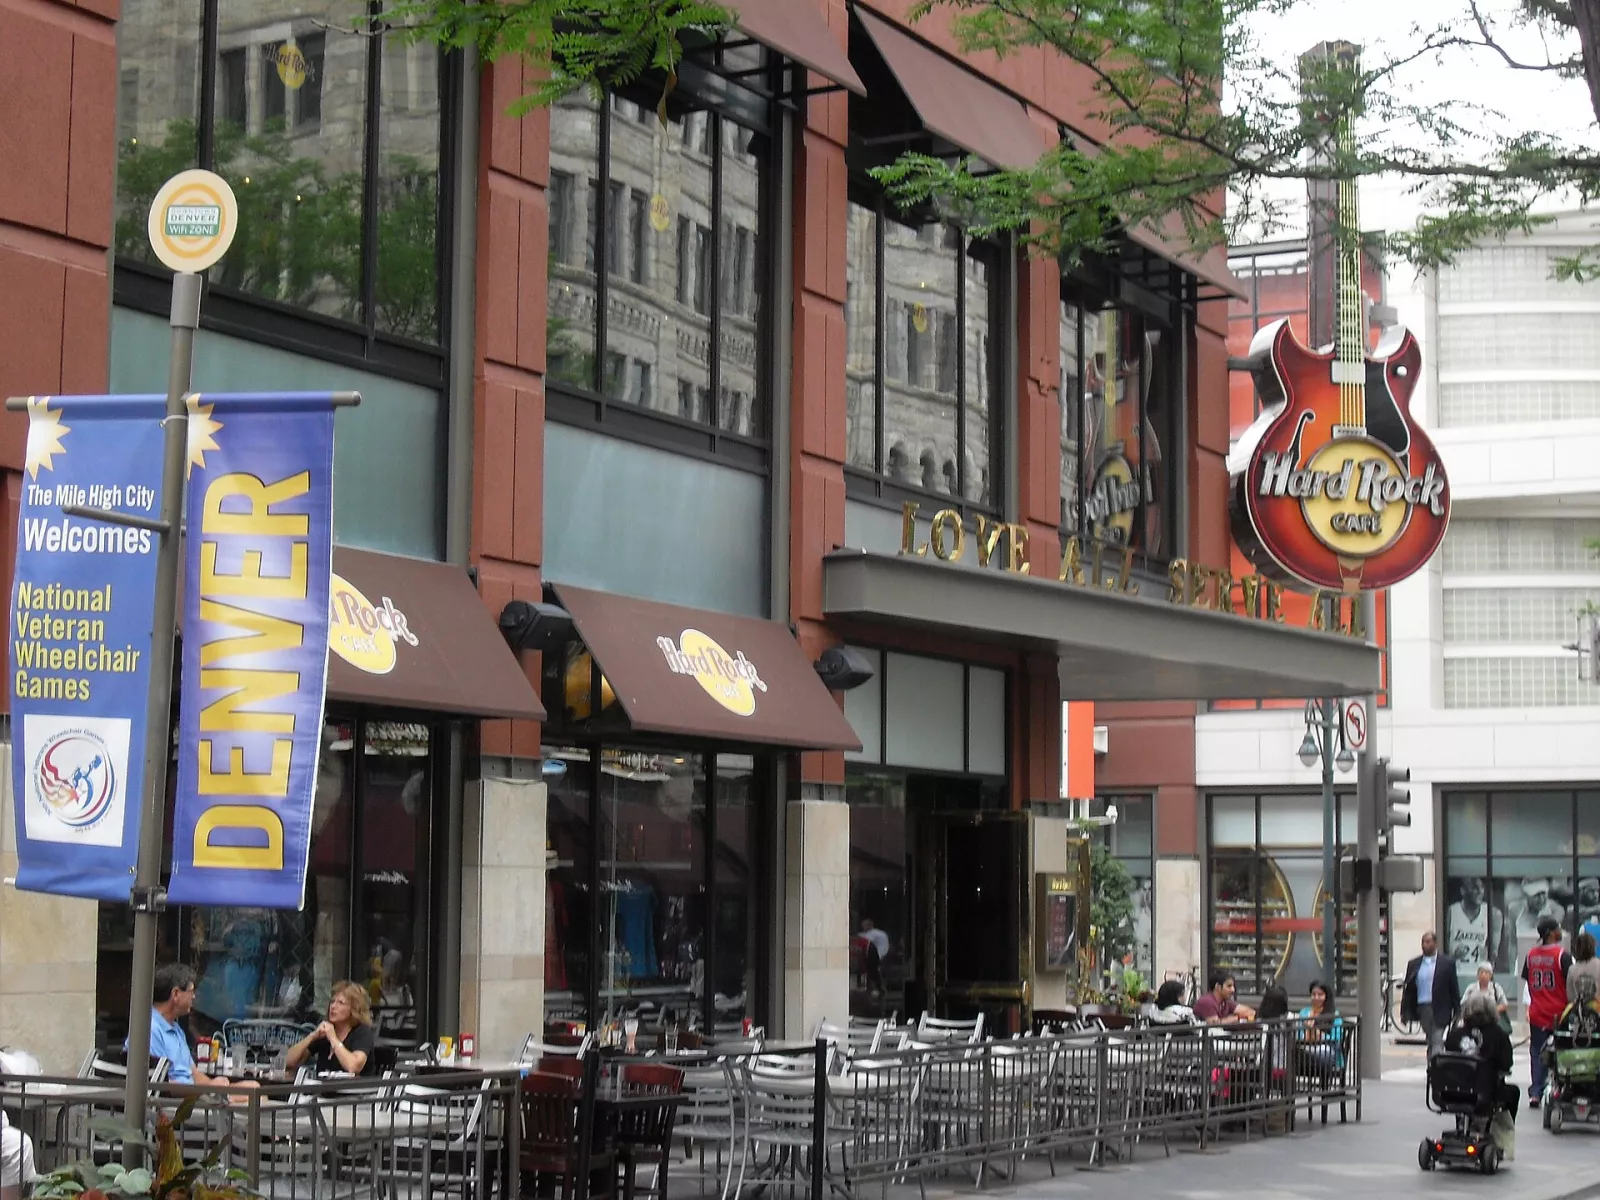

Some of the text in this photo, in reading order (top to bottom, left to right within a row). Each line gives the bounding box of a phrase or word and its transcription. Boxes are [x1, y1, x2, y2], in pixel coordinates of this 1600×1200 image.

[189, 225, 214, 234] ZONE
[27, 484, 155, 511] The Mile High City
[1259, 452, 1445, 516] Hard Rock
[24, 519, 152, 554] Welcomes
[1330, 511, 1382, 535] CAFE
[898, 500, 1368, 638] LOVE ALL SERVE ALL
[17, 581, 112, 612] National
[15, 611, 104, 641] Veteran
[336, 590, 420, 647] Rock
[15, 640, 140, 672] Wheelchair
[193, 469, 311, 870] DENVER
[656, 635, 768, 693] Hard Rock
[15, 671, 91, 700] Games
[1454, 929, 1485, 941] LAKERS
[1460, 945, 1480, 963] 24
